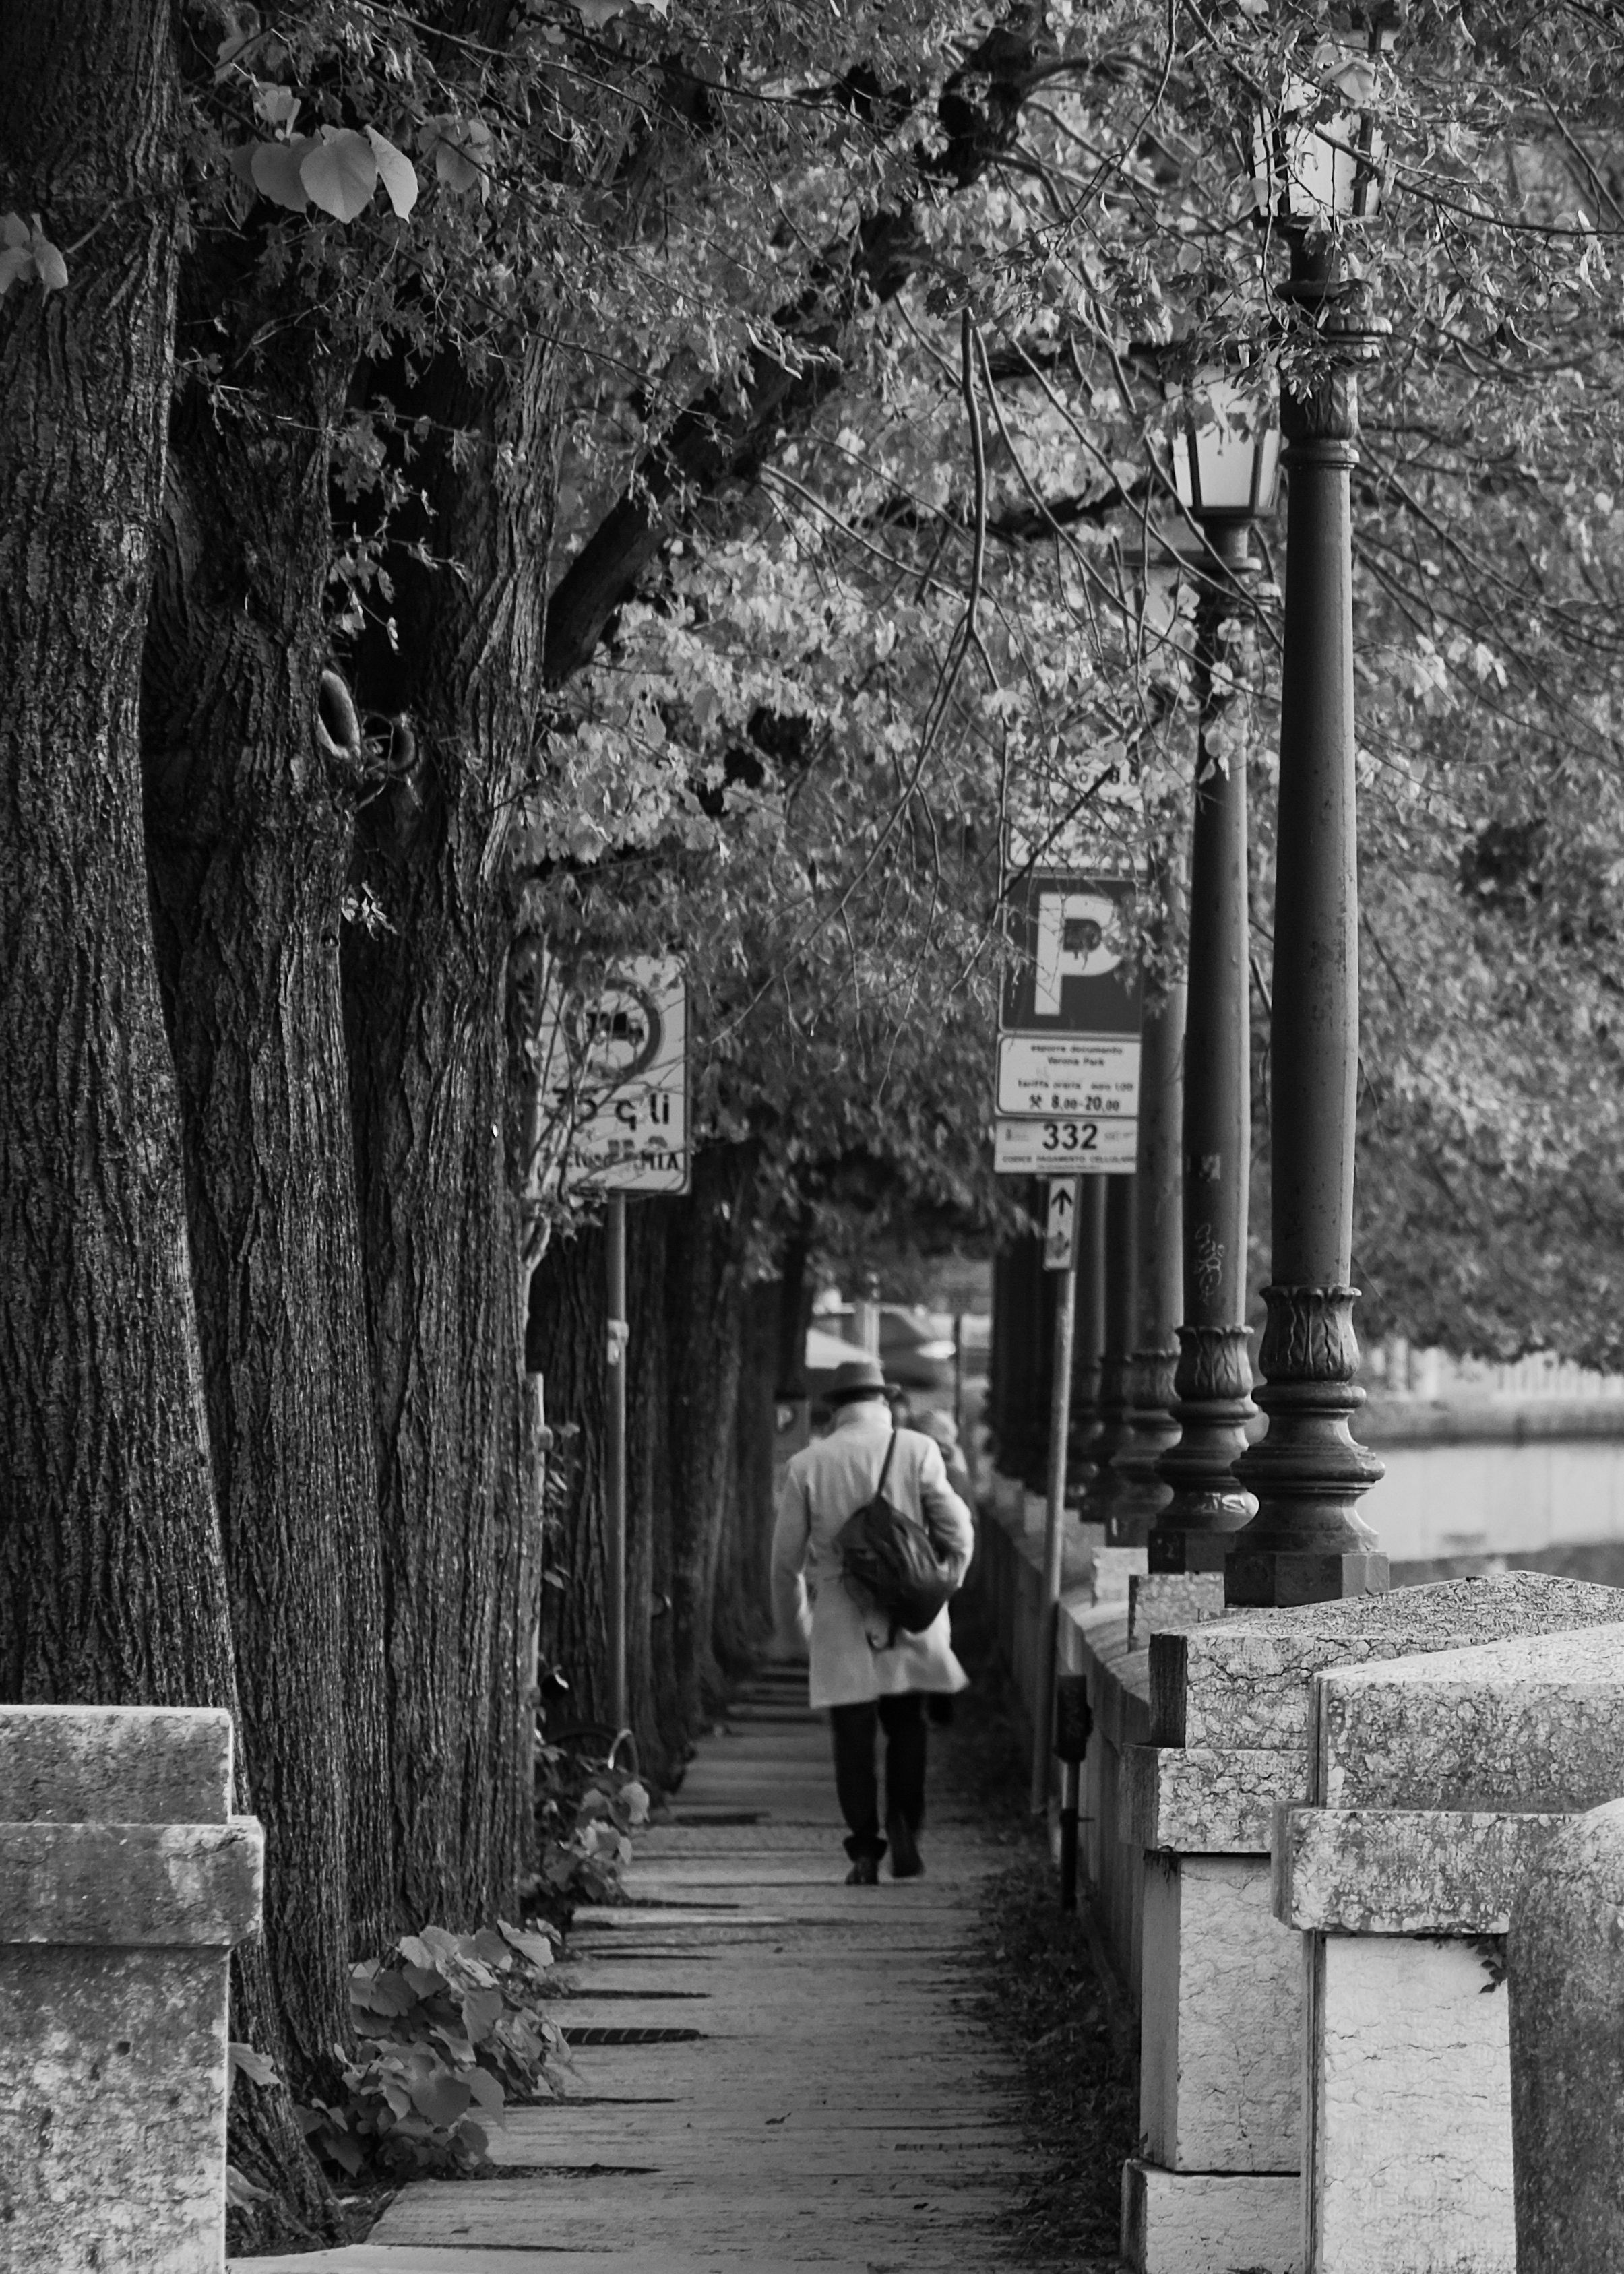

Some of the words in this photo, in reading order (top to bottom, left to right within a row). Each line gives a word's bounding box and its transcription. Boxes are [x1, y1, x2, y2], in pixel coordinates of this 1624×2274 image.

[1034, 893, 1122, 1015] P
[1047, 1056, 1079, 1065] Verona
[1083, 1057, 1104, 1067] Park
[1042, 1123, 1098, 1151] 332
